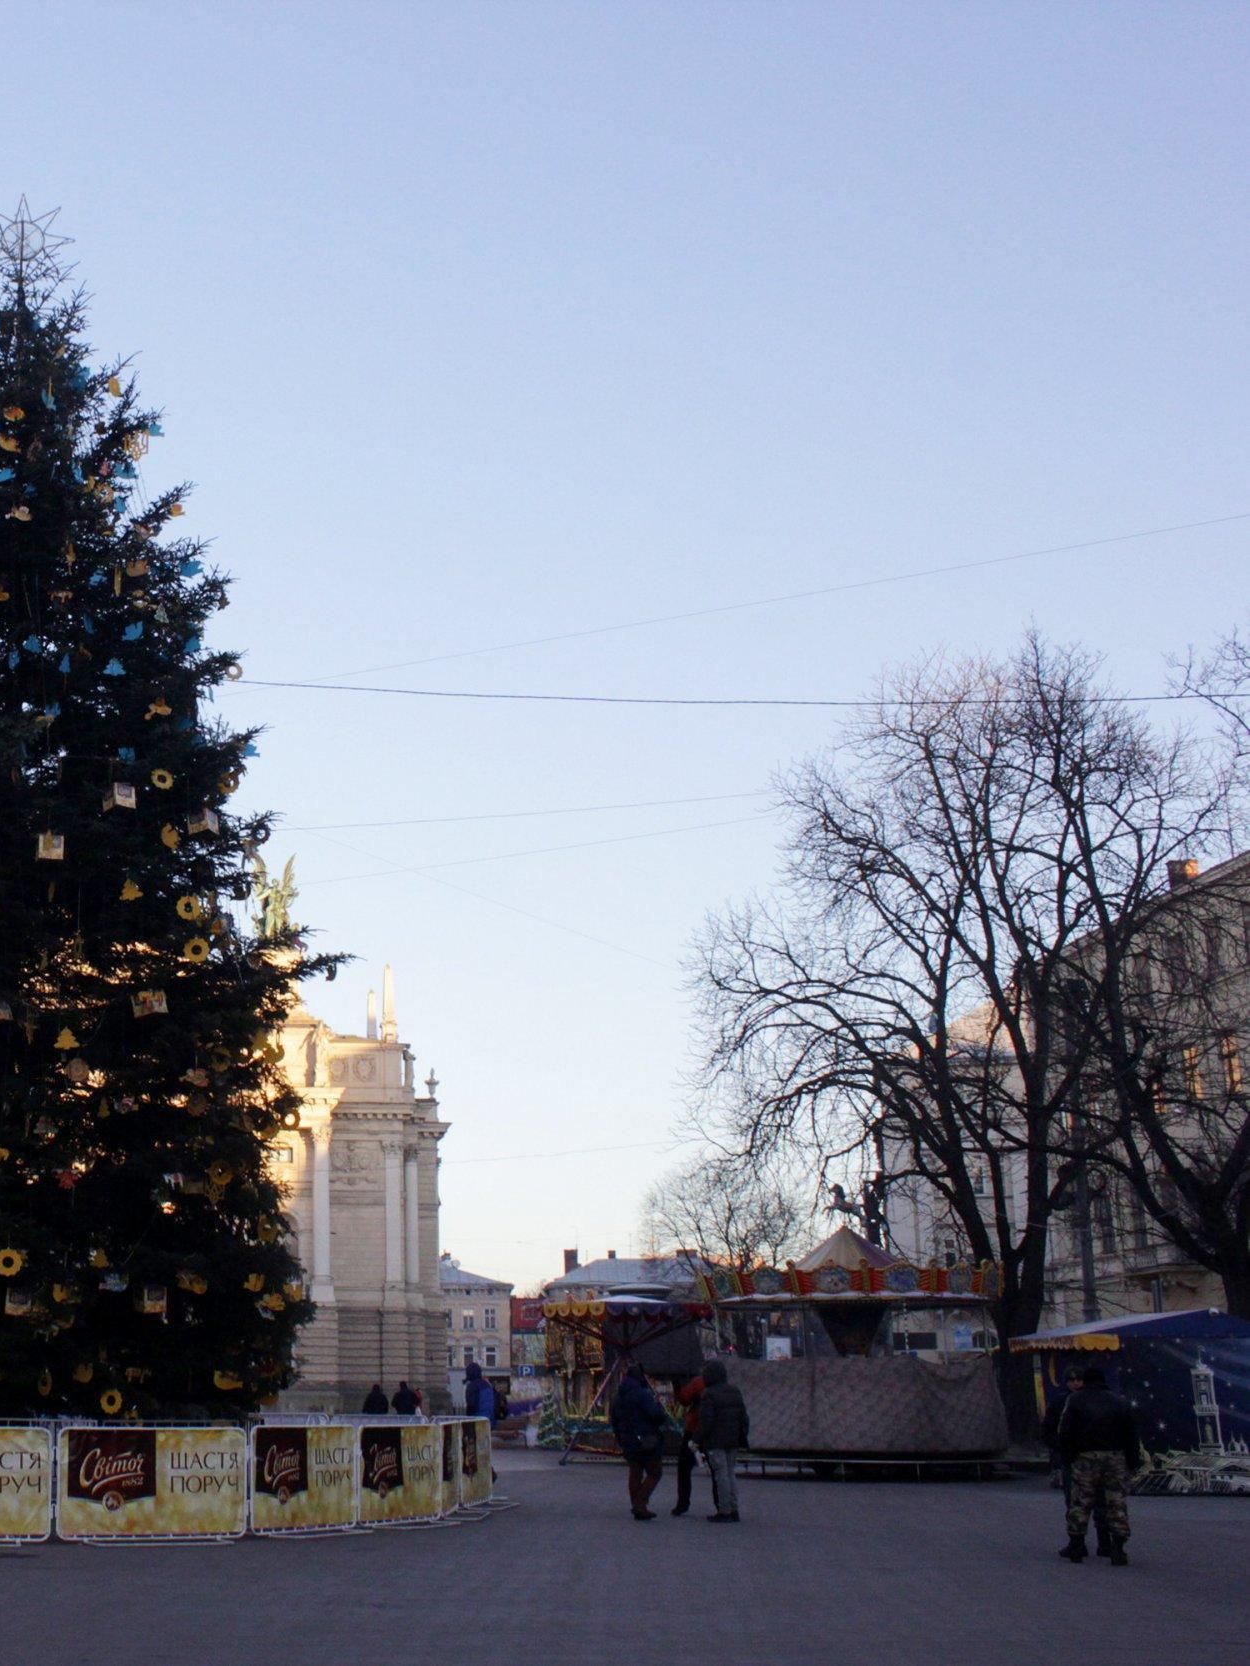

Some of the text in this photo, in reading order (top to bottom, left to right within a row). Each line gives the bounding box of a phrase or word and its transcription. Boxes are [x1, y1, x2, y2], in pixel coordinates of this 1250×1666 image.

[522, 1366, 531, 1376] P
[79, 1448, 145, 1488] Світоч
[171, 1452, 239, 1471] ЩАСТЯ
[171, 1474, 239, 1493] ПОРУЧ
